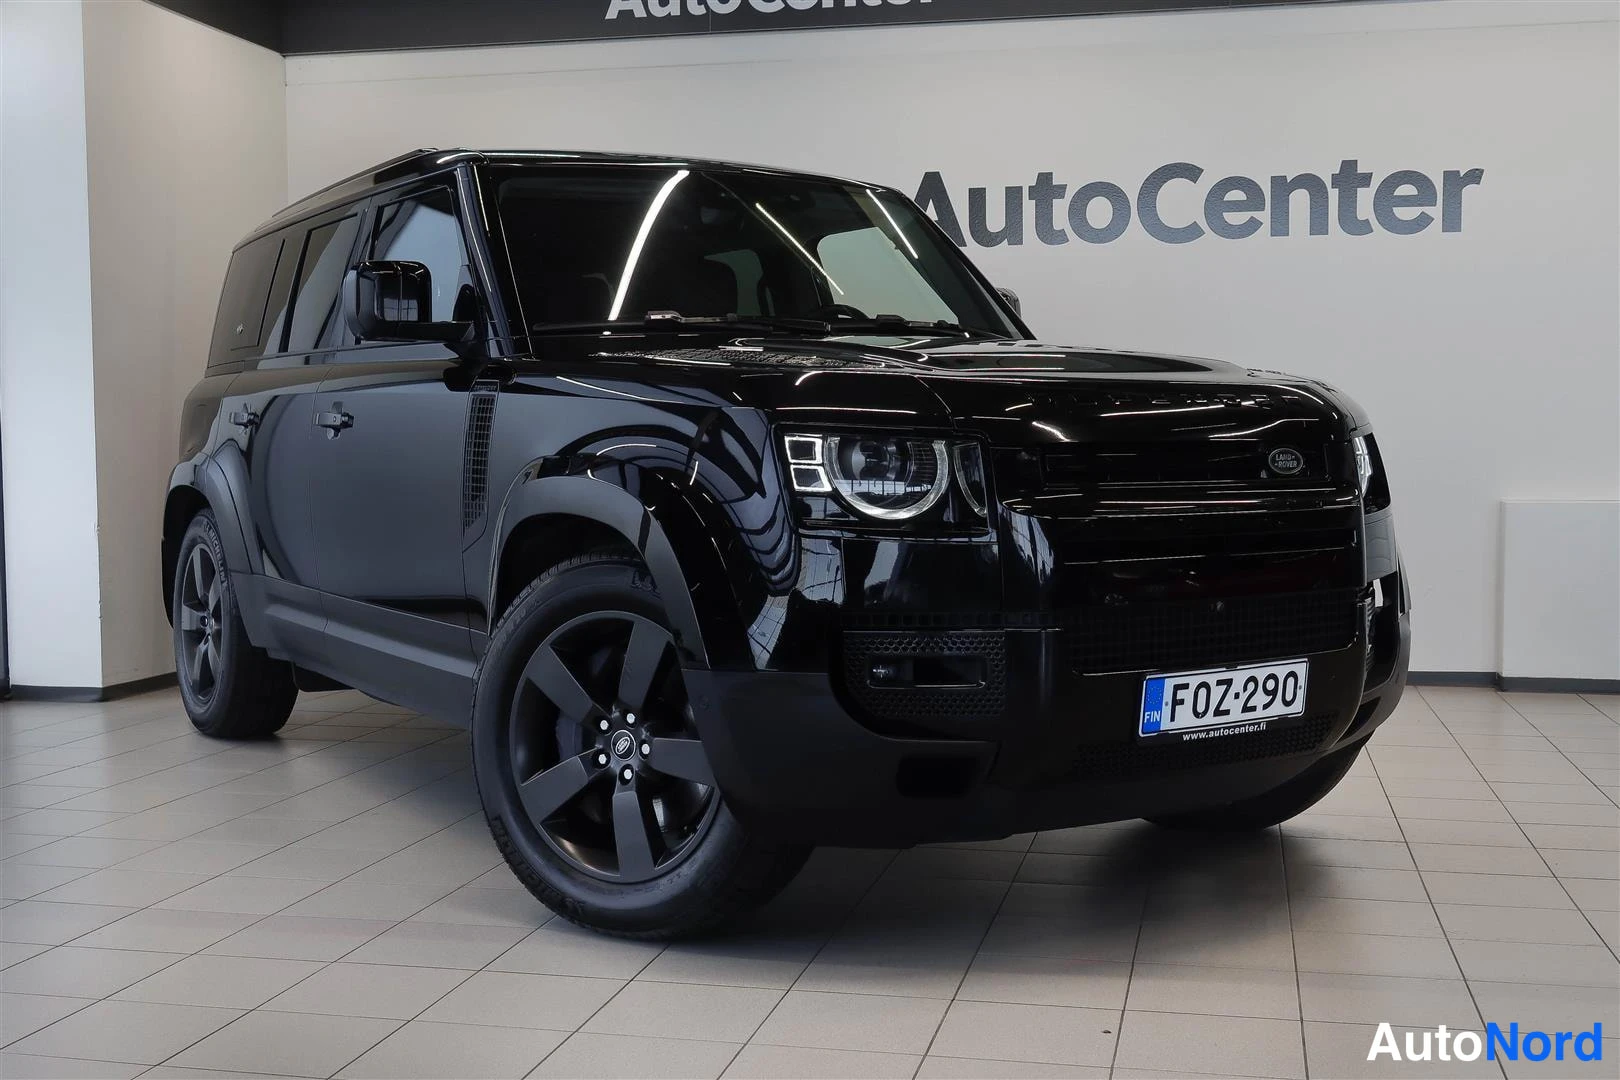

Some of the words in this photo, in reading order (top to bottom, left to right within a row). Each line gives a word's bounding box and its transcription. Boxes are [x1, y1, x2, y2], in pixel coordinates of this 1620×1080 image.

[911, 159, 1485, 248] AutoCenter
[1169, 670, 1299, 722] FOZ-290
[1143, 710, 1161, 724] FIN
[1182, 722, 1267, 741] www.autocenter.fi
